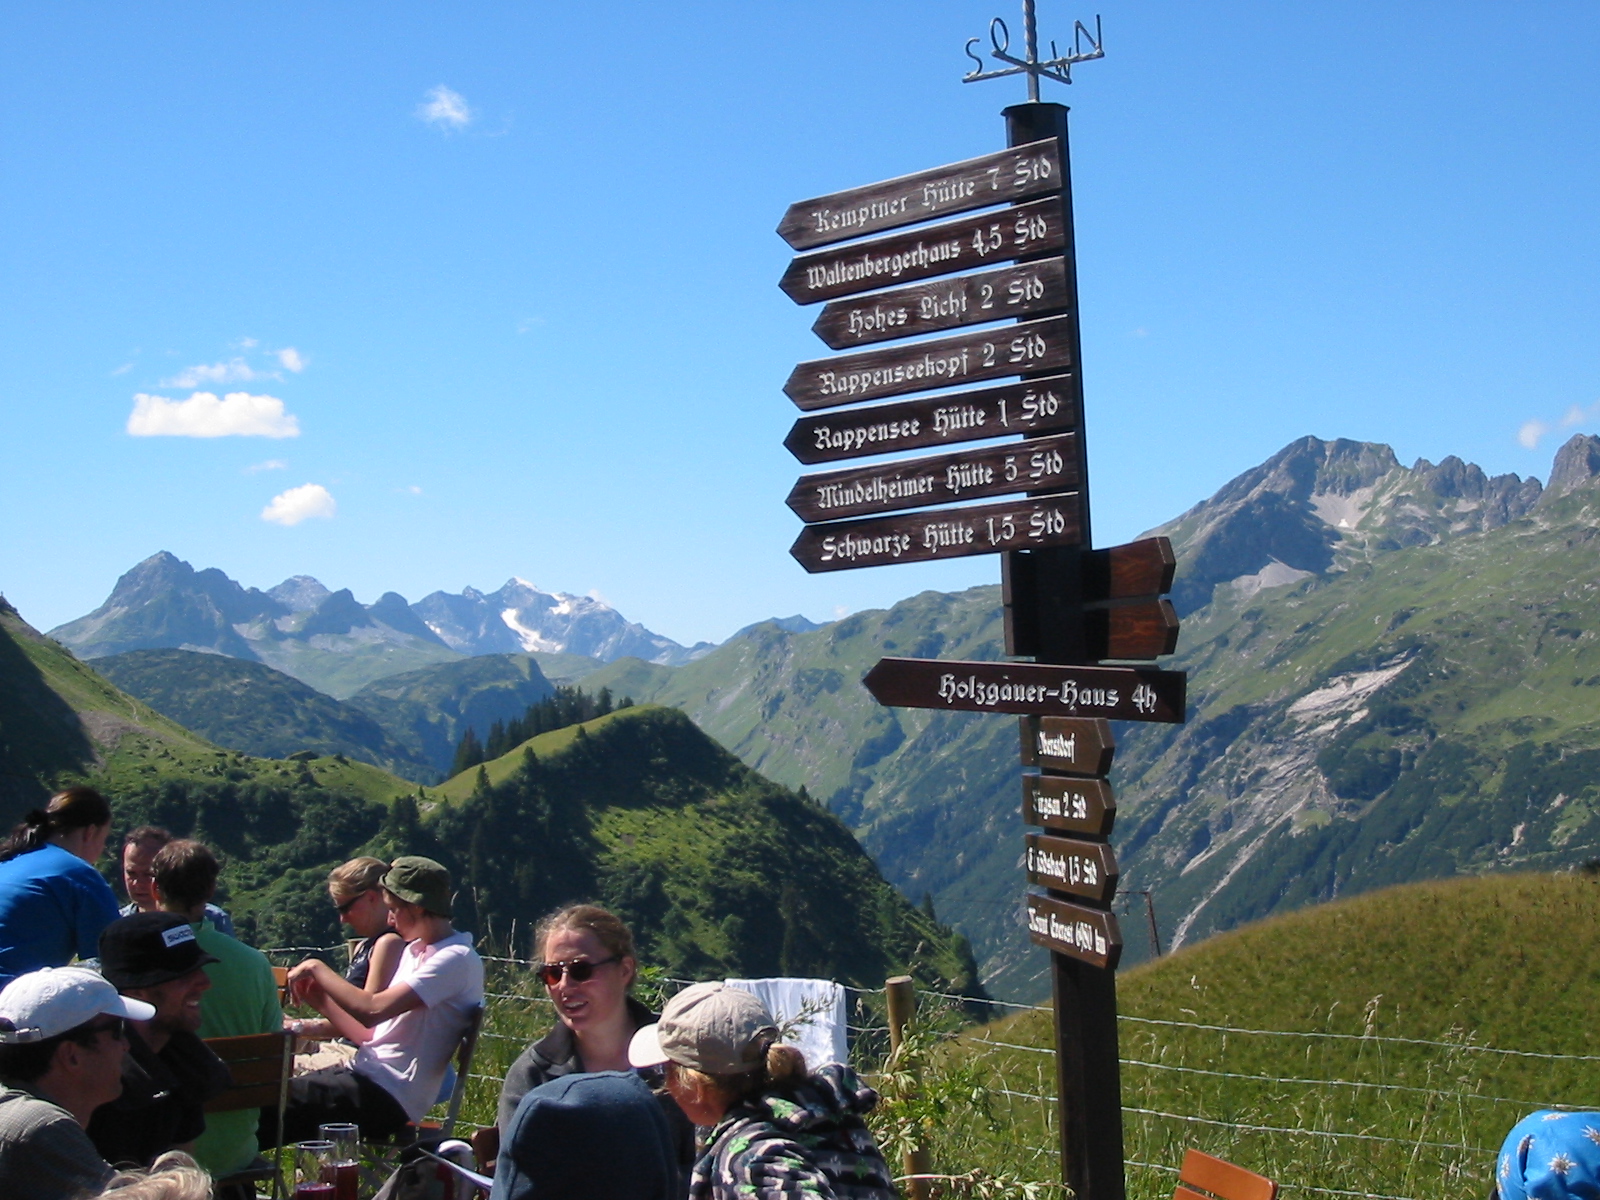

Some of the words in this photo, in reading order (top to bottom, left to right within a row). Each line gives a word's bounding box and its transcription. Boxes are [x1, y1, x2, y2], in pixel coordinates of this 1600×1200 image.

[812, 196, 908, 233] Kemptner
[921, 180, 976, 210] Hütte
[986, 167, 1000, 191] 7
[1013, 156, 1052, 188] Std
[806, 241, 961, 290] Waltenbergerhaus
[1013, 211, 1048, 249] Std
[847, 307, 908, 338] Hohes
[920, 291, 968, 321] Licht
[980, 284, 995, 309] 2
[1007, 275, 1045, 308] Std
[818, 348, 969, 395] Rappenseekopf
[982, 342, 996, 369] 2
[1009, 334, 1047, 366] Std
[813, 419, 921, 452] Rappensee
[932, 404, 987, 437] Hütte
[996, 397, 1010, 427] 1
[1021, 389, 1060, 426] Std
[816, 473, 934, 510] Mindelheimer
[945, 461, 994, 494] Hütte
[1004, 456, 1018, 482] 5
[1028, 448, 1065, 484] Std
[820, 531, 911, 562] Schwarze
[922, 522, 975, 552] Hütte
[1028, 507, 1066, 542] Std
[1130, 683, 1158, 713] 4h
